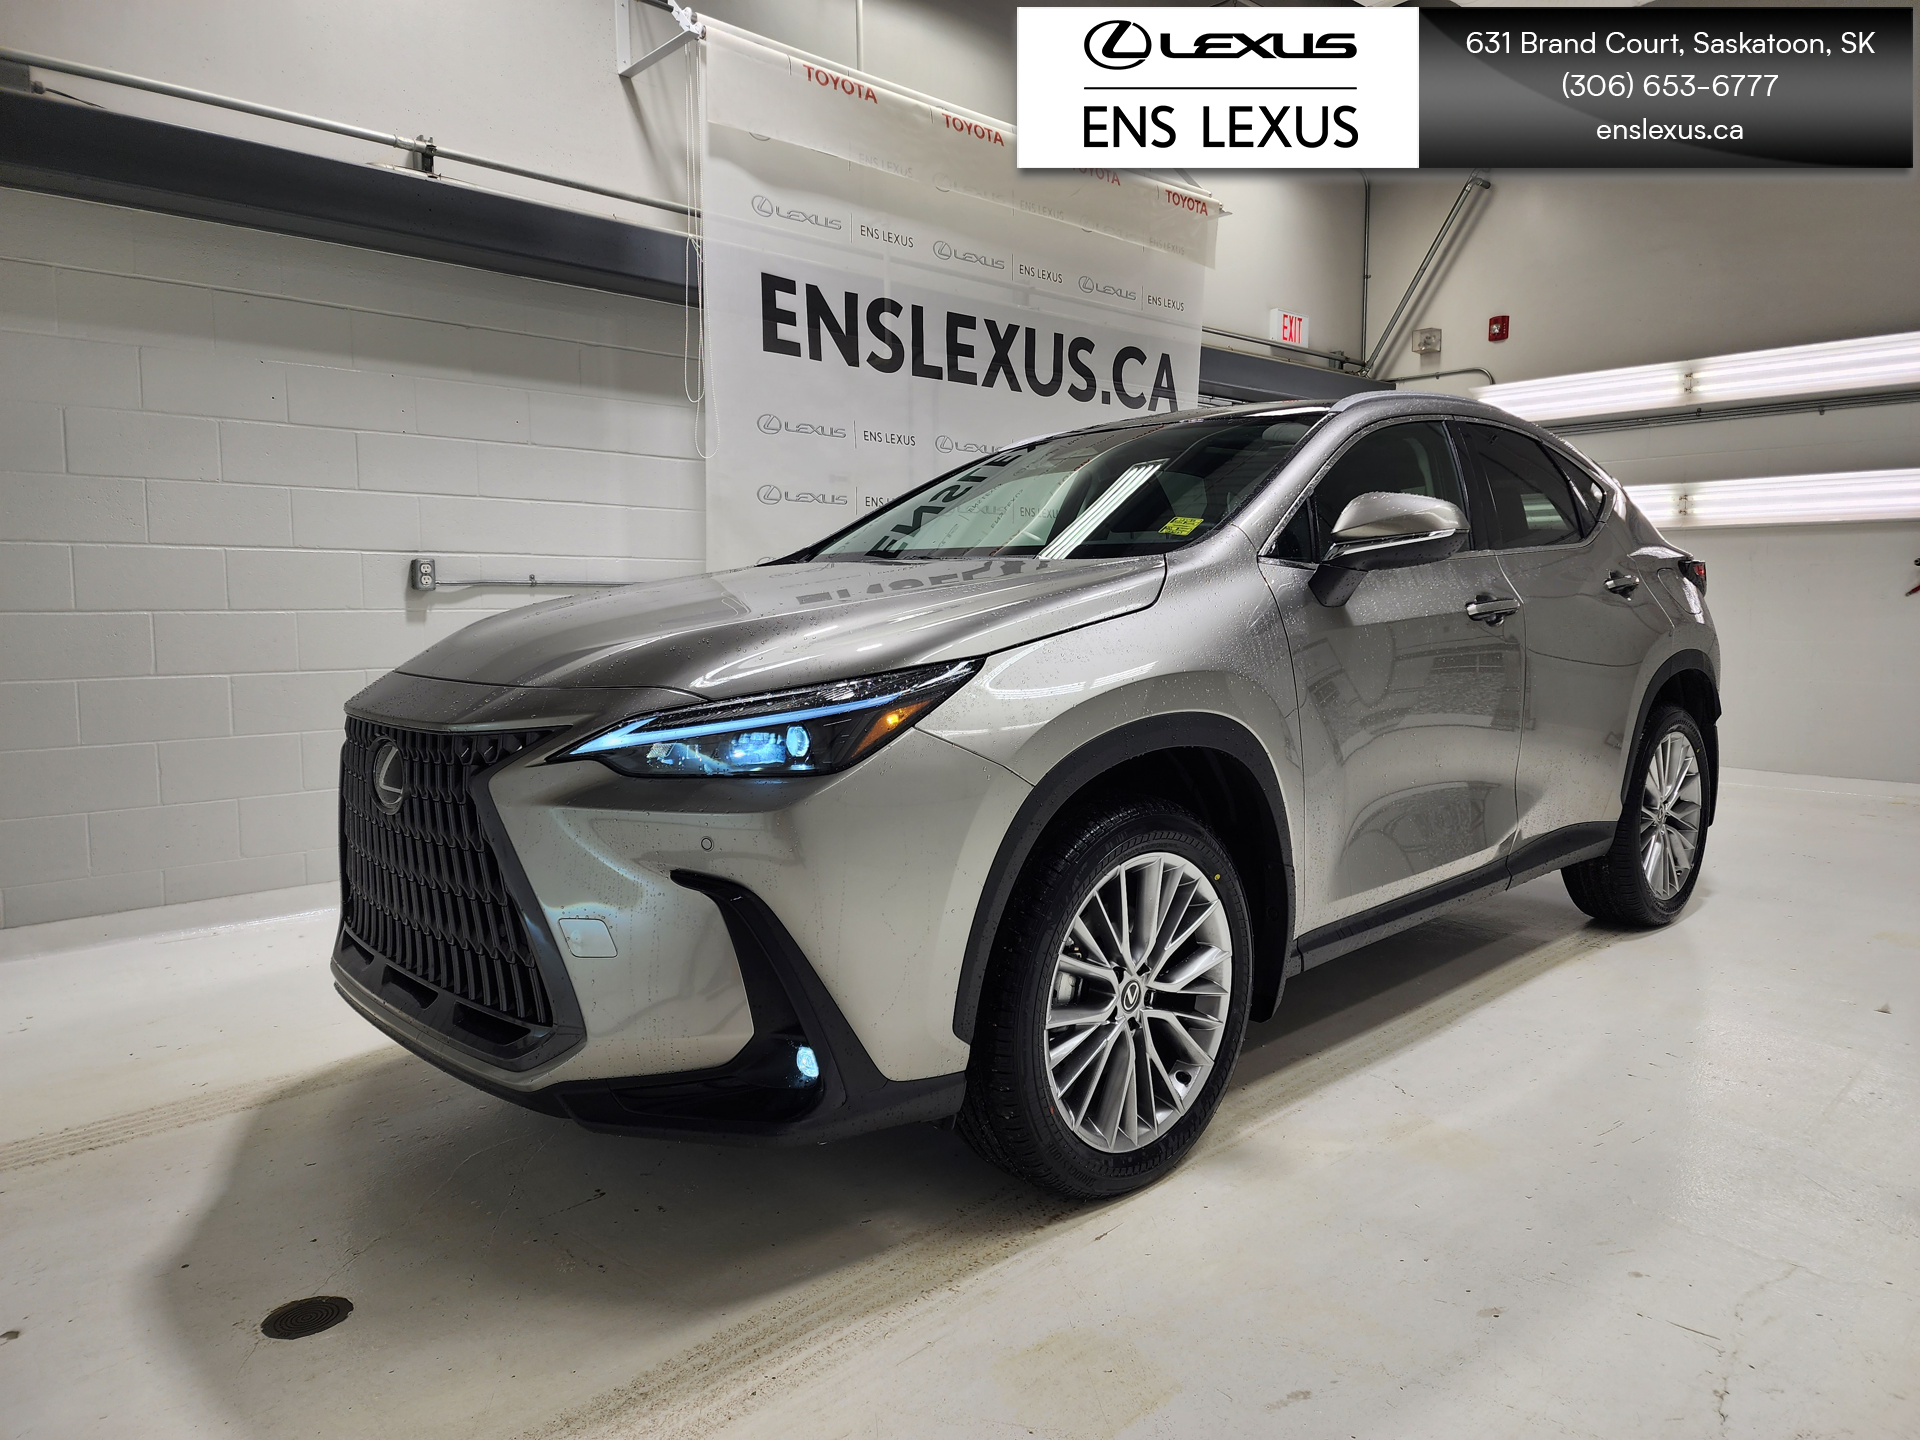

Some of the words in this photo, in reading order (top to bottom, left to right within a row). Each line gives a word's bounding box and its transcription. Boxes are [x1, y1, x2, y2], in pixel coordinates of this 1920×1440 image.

[803, 64, 877, 104] TOYOTA
[942, 113, 1005, 147] TOYOTA
[1165, 189, 1208, 216] TOYOTA
[775, 205, 842, 230] LEXUS
[860, 224, 880, 240] ENS
[882, 231, 914, 248] LEXUS
[954, 249, 1005, 270] LEXUS
[1019, 264, 1035, 277] ENS
[1037, 268, 1063, 283] LEXUS
[1095, 282, 1137, 301] LEXUS
[1147, 295, 1162, 306] ENS
[1163, 298, 1185, 312] LEXUS
[761, 272, 1179, 413] ENSLEXUS.CA
[1282, 313, 1303, 344] EXIT
[784, 421, 847, 439] LEXUS
[863, 430, 883, 443] ENS
[885, 432, 916, 447] LEXUS
[784, 490, 848, 505] LEXUS
[865, 496, 884, 507] ENS
[1020, 506, 1036, 517] ENS
